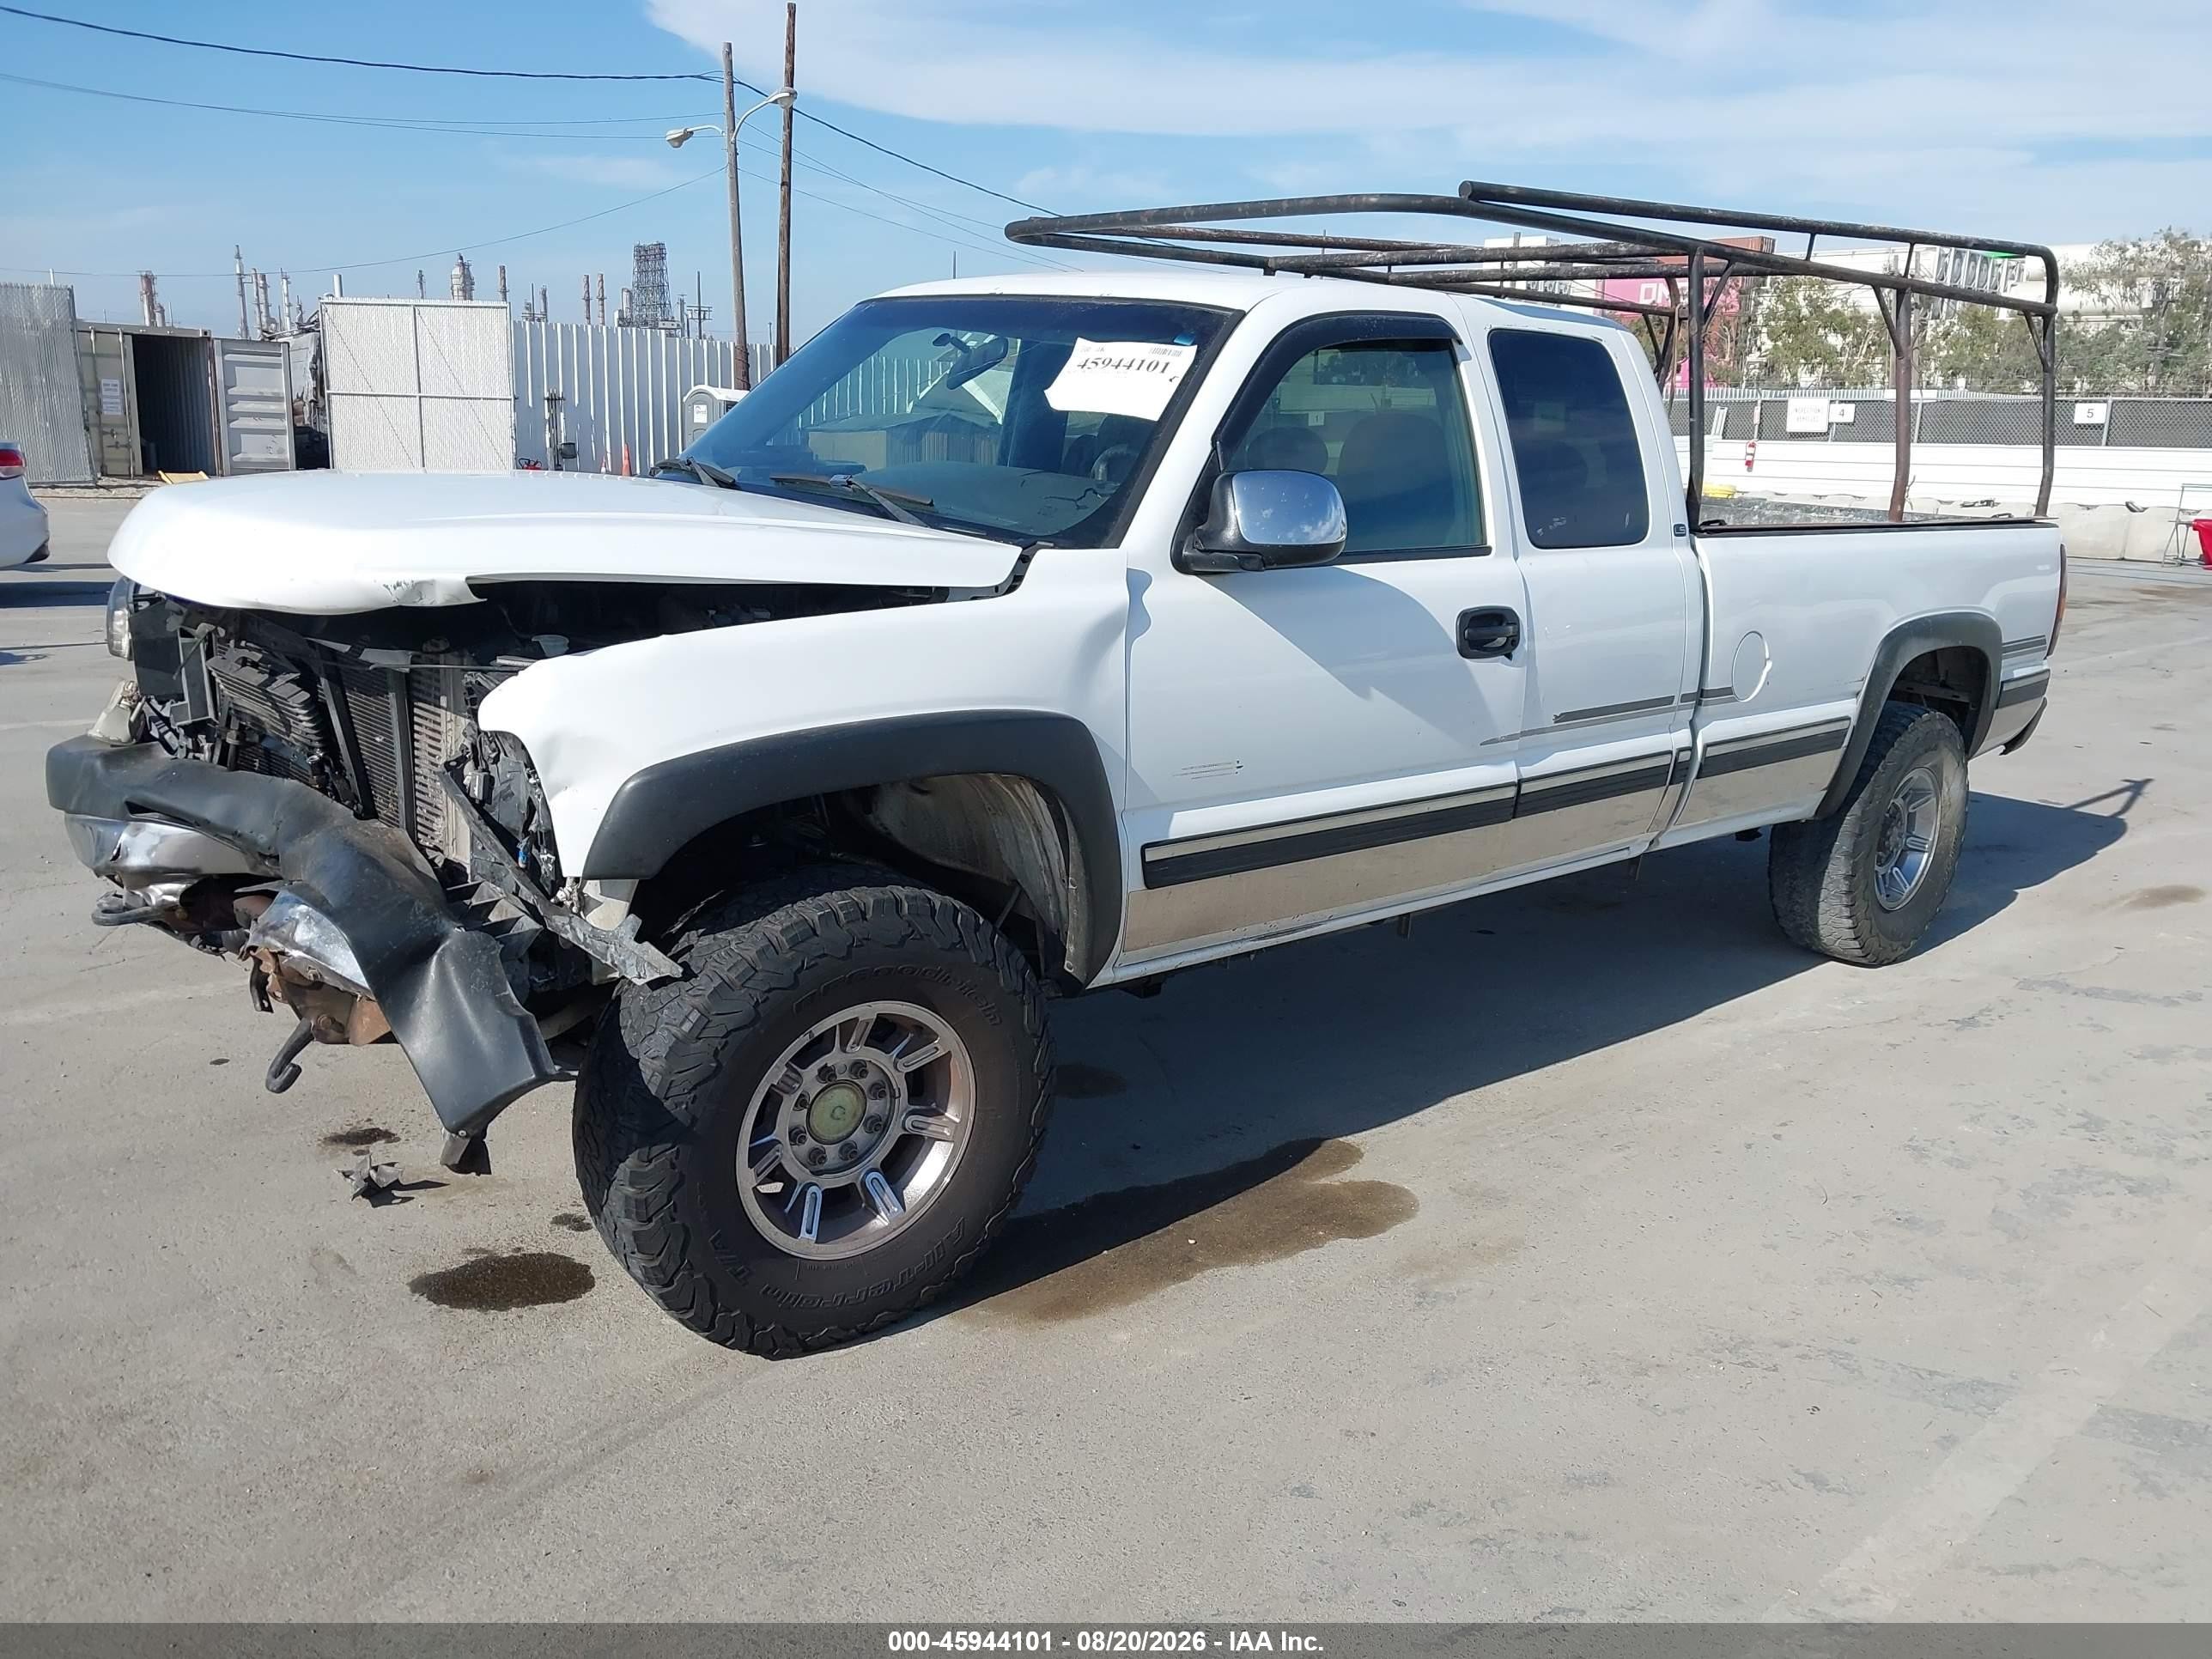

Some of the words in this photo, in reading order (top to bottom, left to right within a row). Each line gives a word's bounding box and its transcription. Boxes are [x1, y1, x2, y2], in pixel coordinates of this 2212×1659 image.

[1077, 357, 1170, 374] 45944101
[1838, 408, 1844, 417] 4
[2087, 408, 2094, 419] 5
